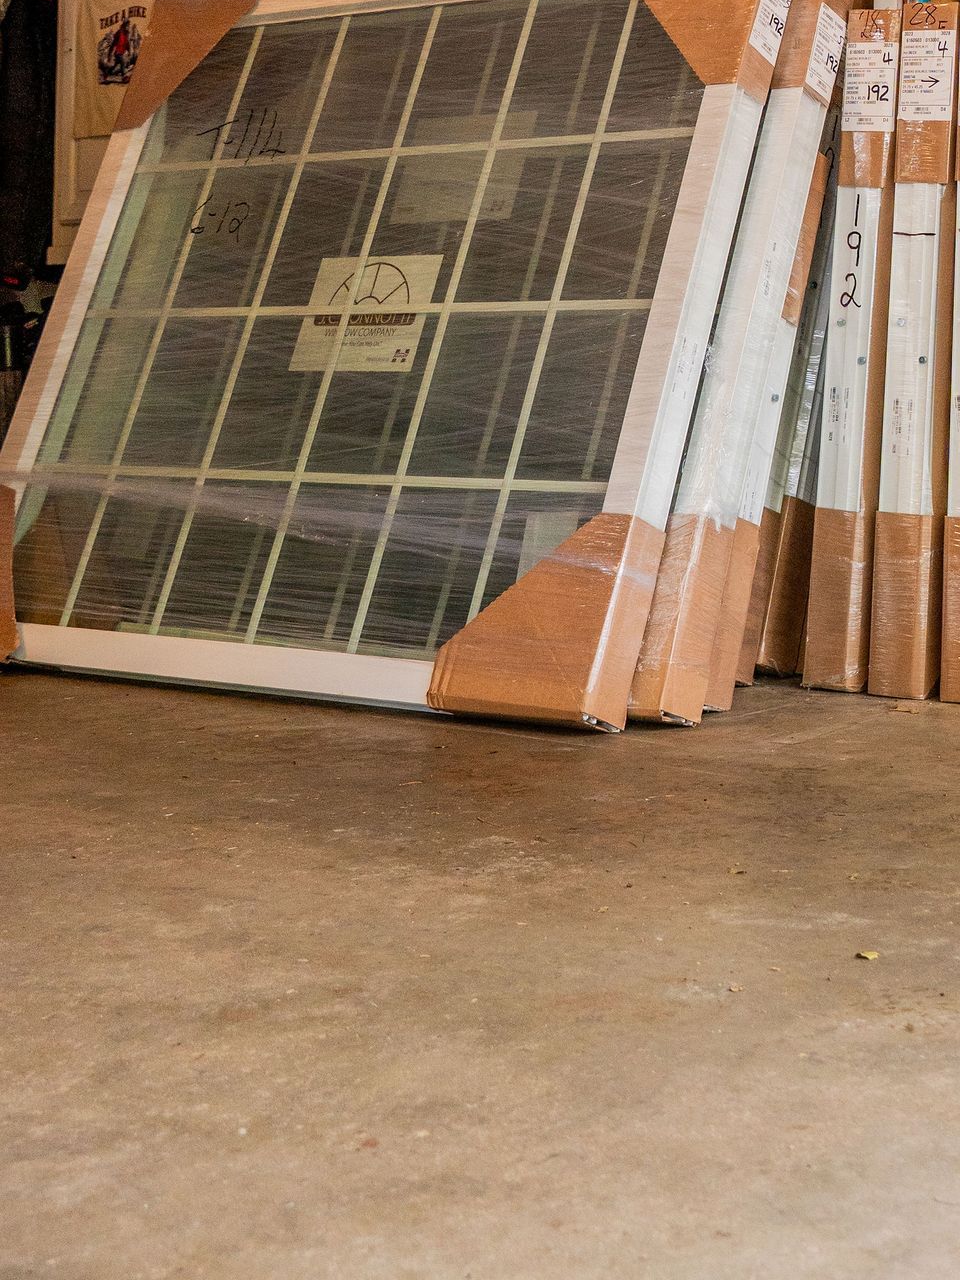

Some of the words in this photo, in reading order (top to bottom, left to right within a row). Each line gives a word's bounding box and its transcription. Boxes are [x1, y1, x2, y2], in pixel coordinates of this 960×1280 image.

[100, 11, 120, 29] TAKE
[128, 5, 147, 18] HIKE
[909, 3, 937, 25] 28
[769, 14, 784, 37] 192
[882, 51, 894, 65] 4
[937, 40, 949, 59] 4
[825, 53, 839, 74] 192
[867, 84, 889, 102] 192
[359, 327, 397, 337] COMPANY
